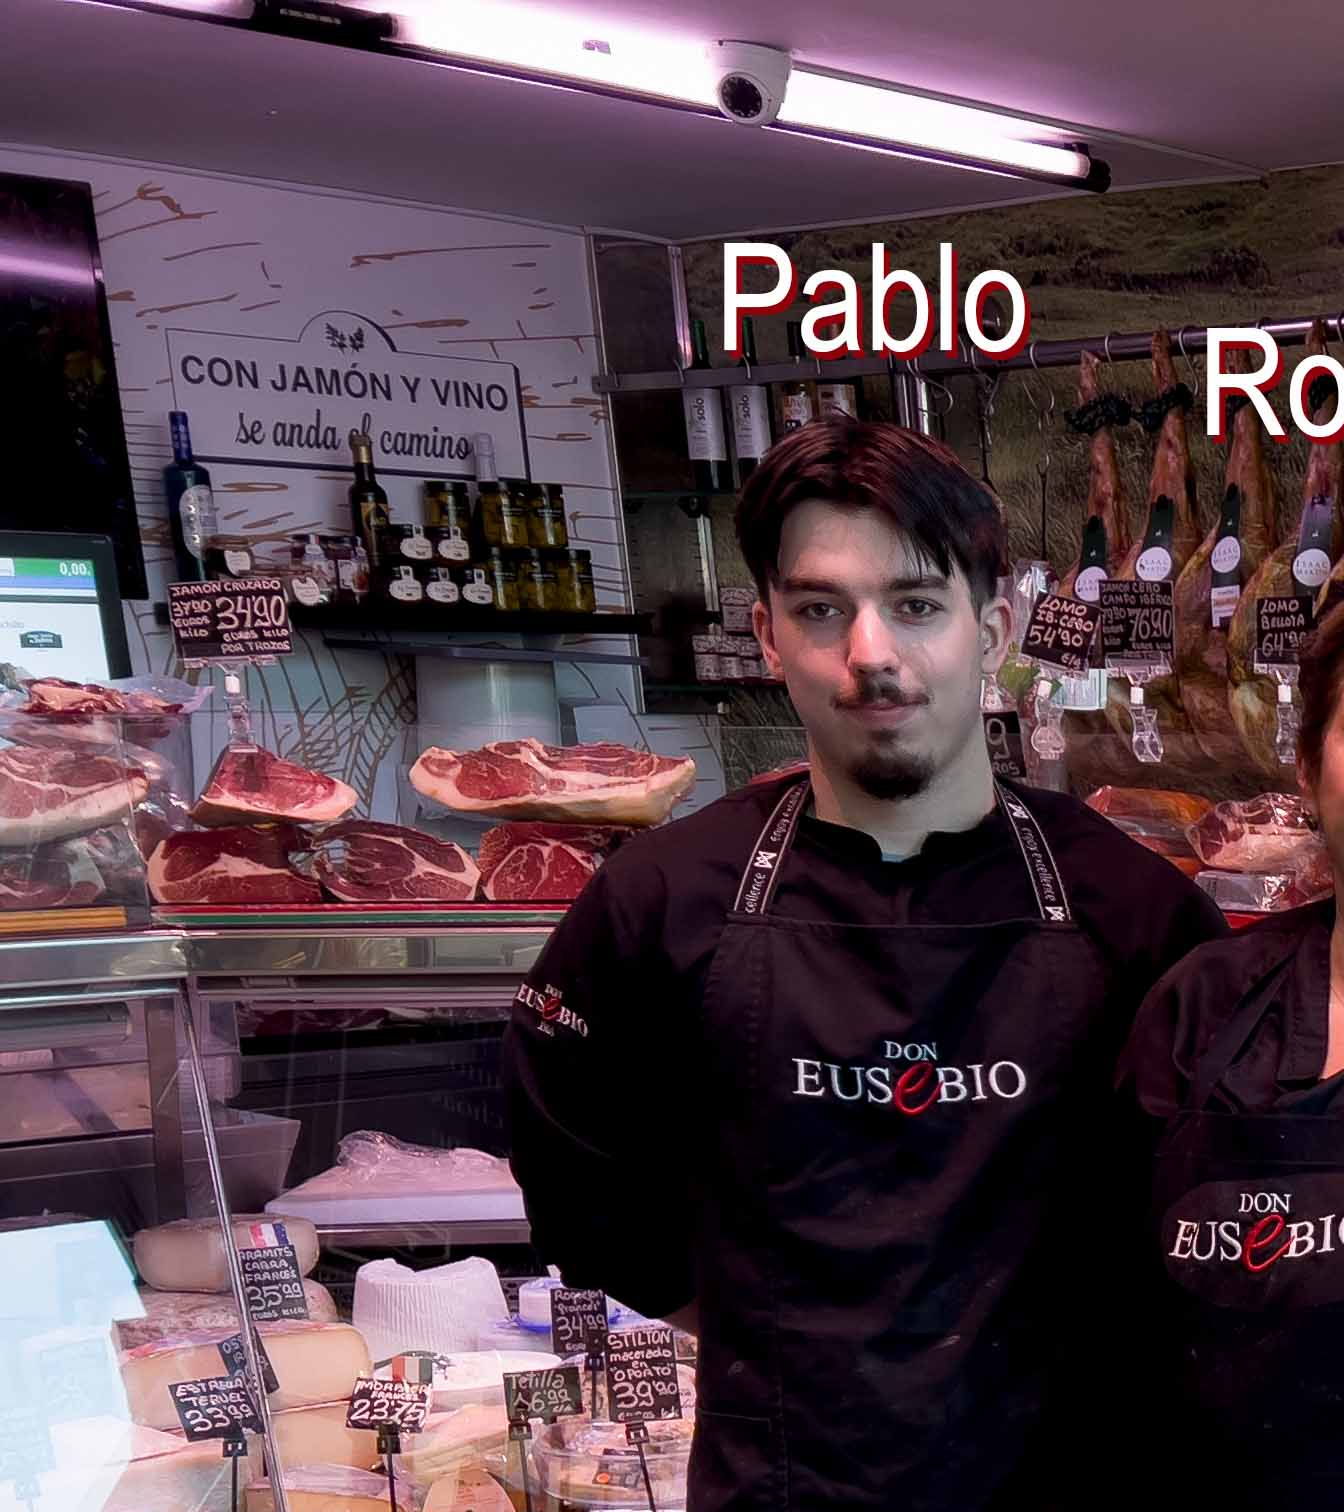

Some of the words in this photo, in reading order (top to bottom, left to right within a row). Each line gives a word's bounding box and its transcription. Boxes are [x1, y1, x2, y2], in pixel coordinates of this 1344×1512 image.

[180, 354, 260, 389] CON
[270, 362, 393, 402] JAMÓN
[400, 376, 422, 402] Y
[431, 378, 508, 411] VINO
[235, 412, 266, 445] se
[272, 409, 342, 451] anda
[381, 427, 473, 461] camino
[1039, 594, 1088, 617] LOMO
[1261, 599, 1300, 615] LOMO
[883, 1040, 938, 1063] DON
[1238, 1192, 1292, 1213] DON
[607, 1328, 673, 1350] STILTON
[609, 1348, 673, 1363] macerado
[631, 1360, 649, 1369] en
[505, 1370, 566, 1391] Tetilla
